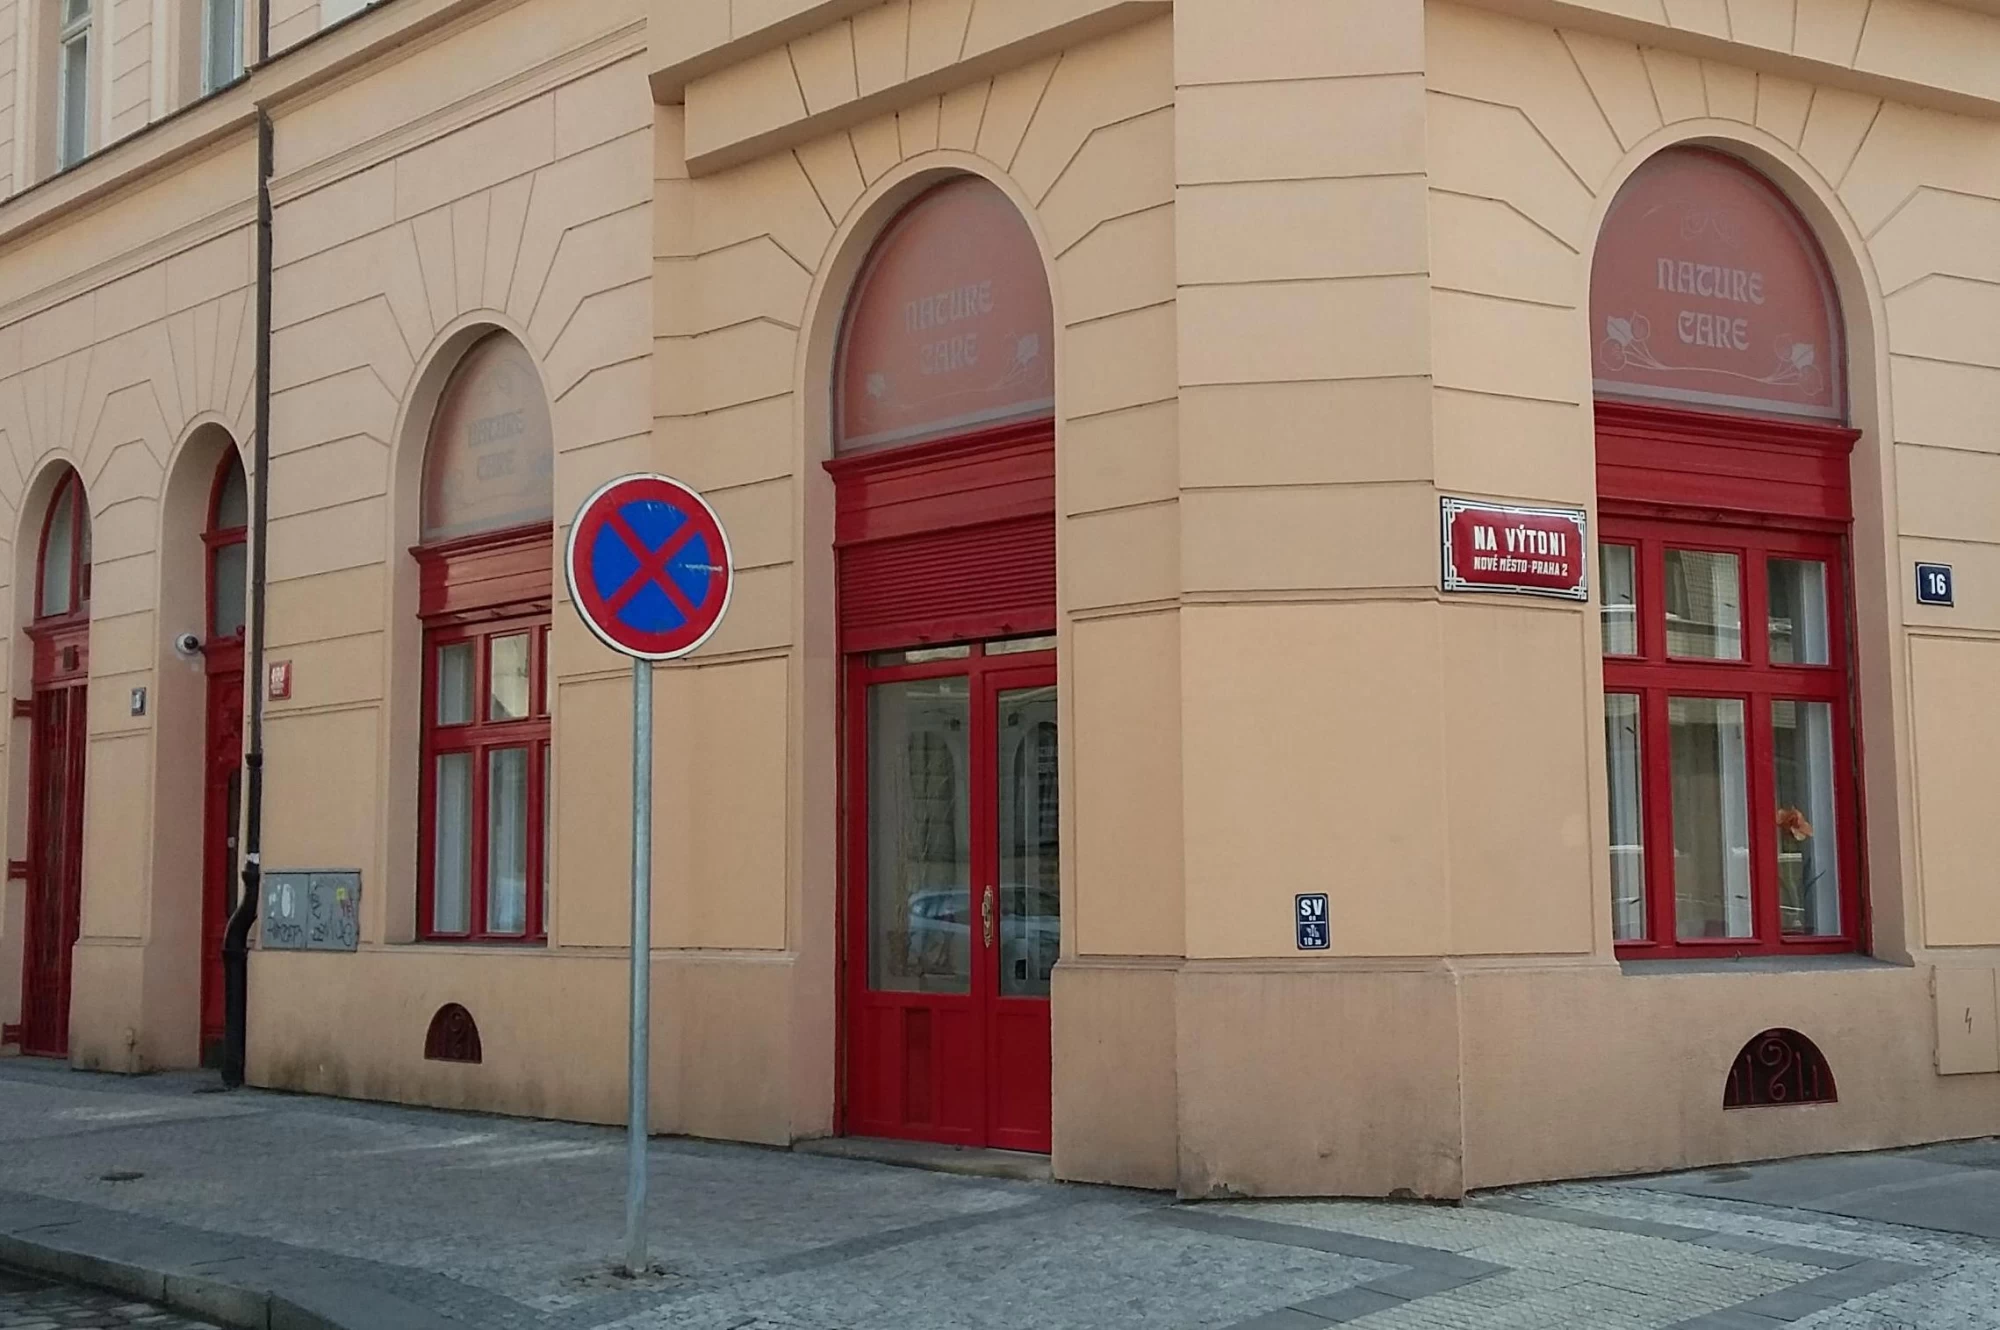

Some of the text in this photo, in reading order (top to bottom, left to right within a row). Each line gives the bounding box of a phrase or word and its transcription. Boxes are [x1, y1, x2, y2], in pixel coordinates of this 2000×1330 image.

[1656, 257, 1765, 305] NATURE
[904, 279, 994, 334] NATURE
[1677, 310, 1750, 351] CARE
[920, 332, 978, 375] CARE
[1474, 523, 1566, 557] NA VÝTONI
[1474, 554, 1498, 571] NOVÉ
[1561, 563, 1568, 577] 2
[1928, 572, 1947, 596] 16
[1301, 899, 1323, 916] SV
[1304, 937, 1313, 946] 10
